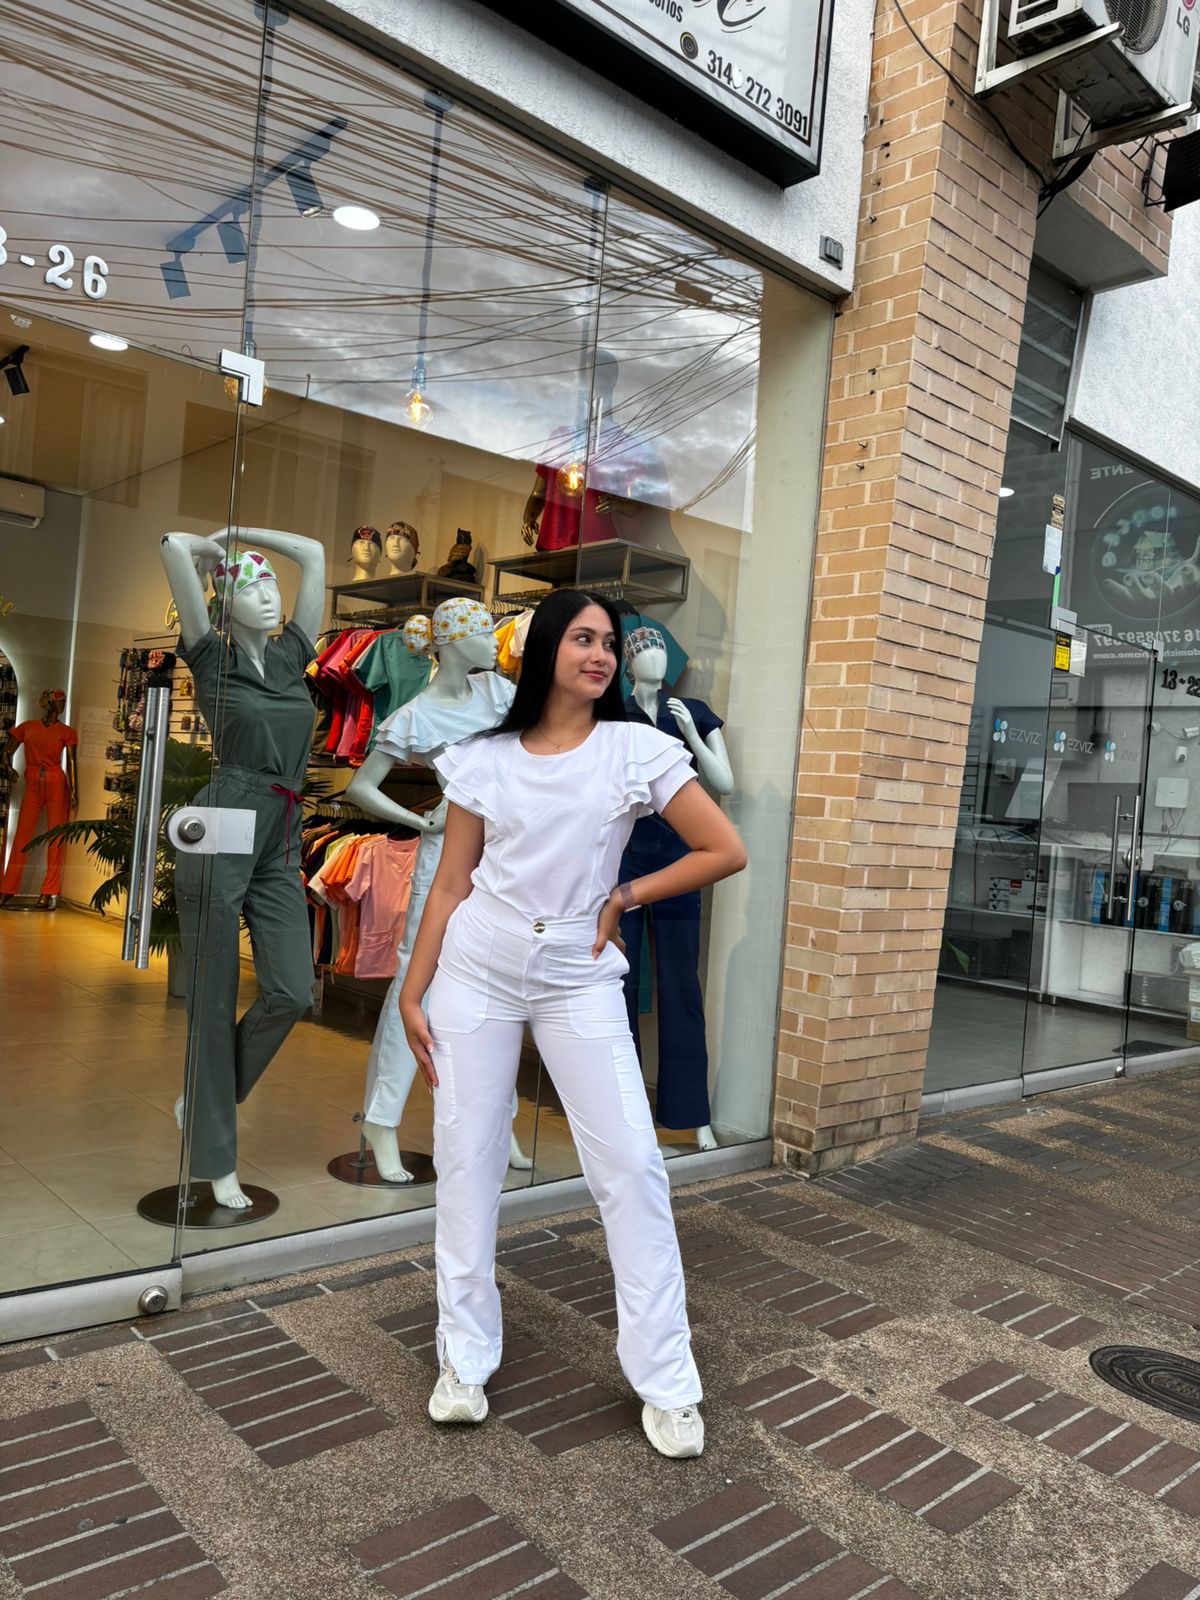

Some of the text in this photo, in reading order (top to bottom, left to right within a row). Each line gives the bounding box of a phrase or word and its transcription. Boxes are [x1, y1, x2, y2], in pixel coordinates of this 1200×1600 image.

[1176, 6, 1190, 37] LG
[707, 50, 808, 137] 314 272 3091
[1008, 728, 1041, 745] EZVIZ
[1066, 738, 1094, 754] EZVIZ
